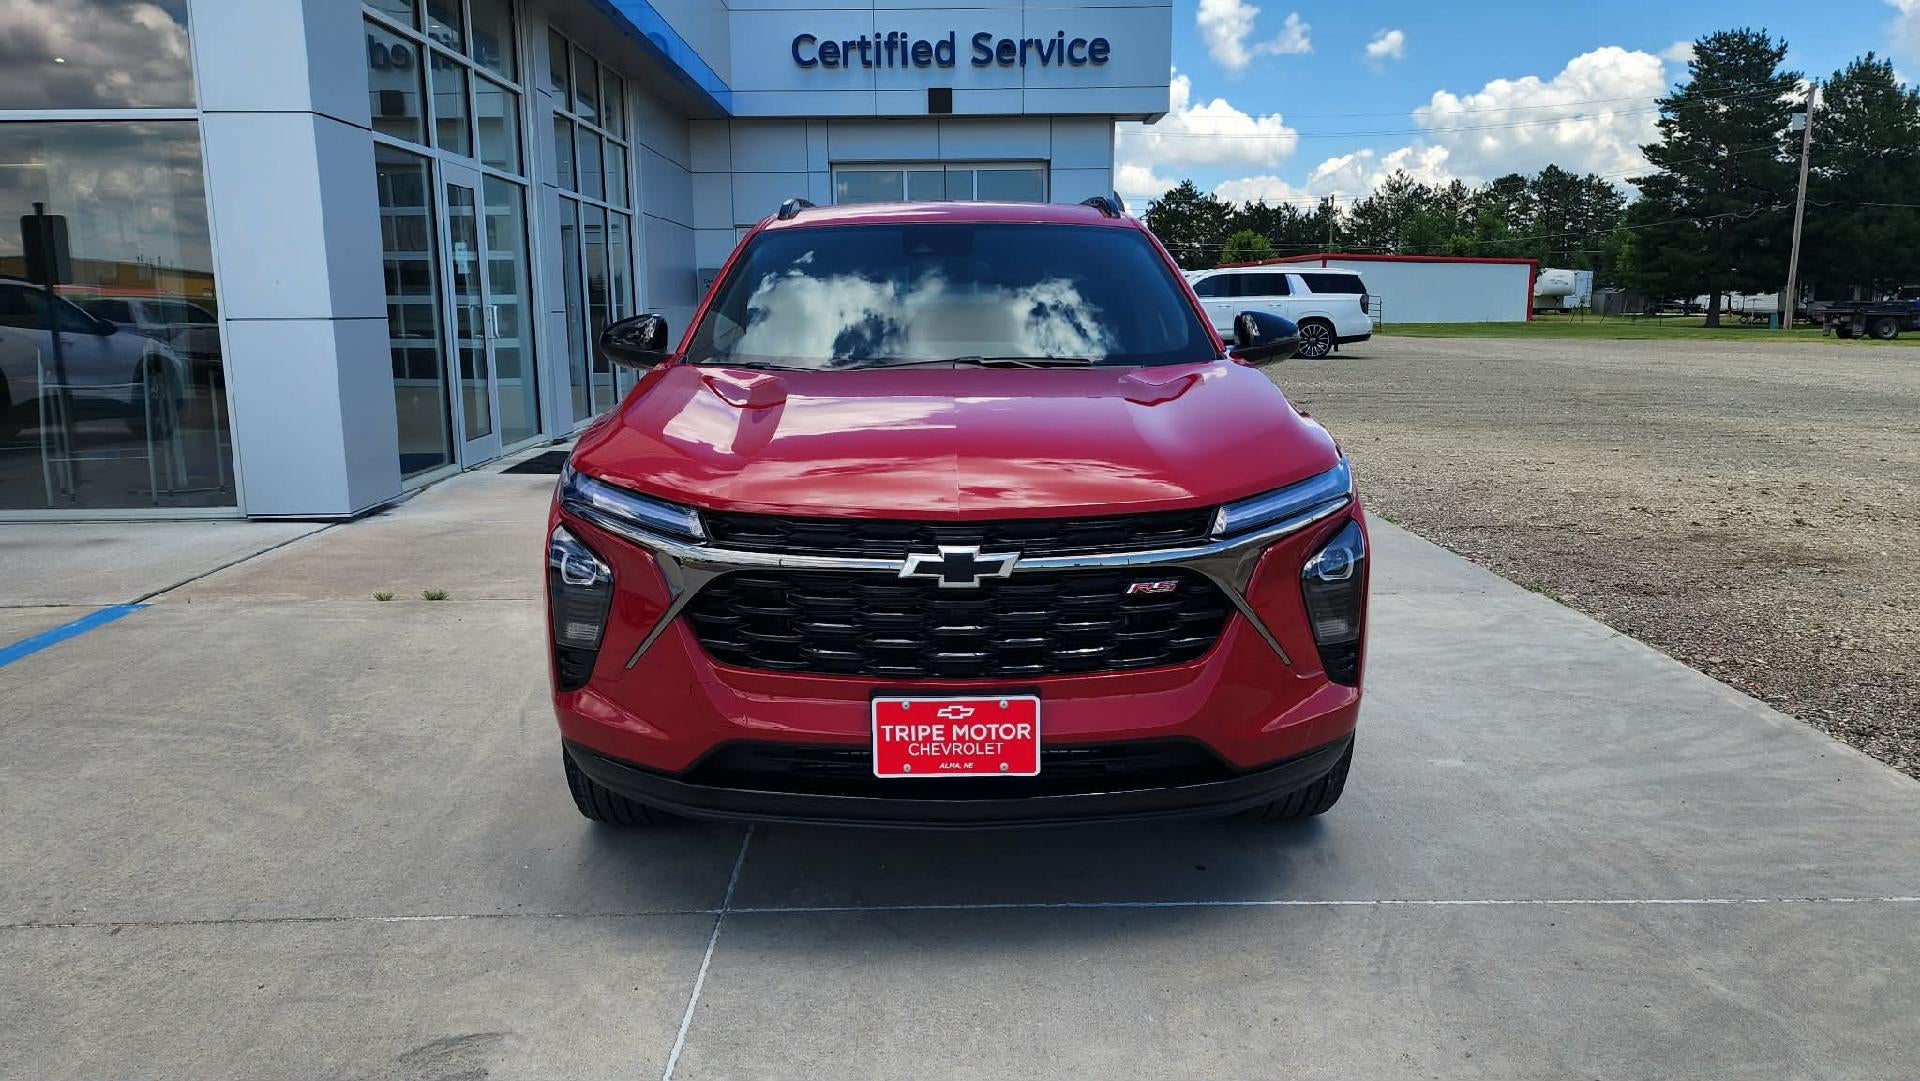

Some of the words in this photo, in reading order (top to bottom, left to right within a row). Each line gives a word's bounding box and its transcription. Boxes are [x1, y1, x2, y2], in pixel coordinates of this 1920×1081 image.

[791, 31, 956, 68] Certified
[970, 30, 1111, 67] Service
[1126, 580, 1179, 594] RS
[880, 725, 945, 742] TRIPE
[952, 723, 1031, 741] MOTOR
[908, 742, 1004, 756] CHEVROLET
